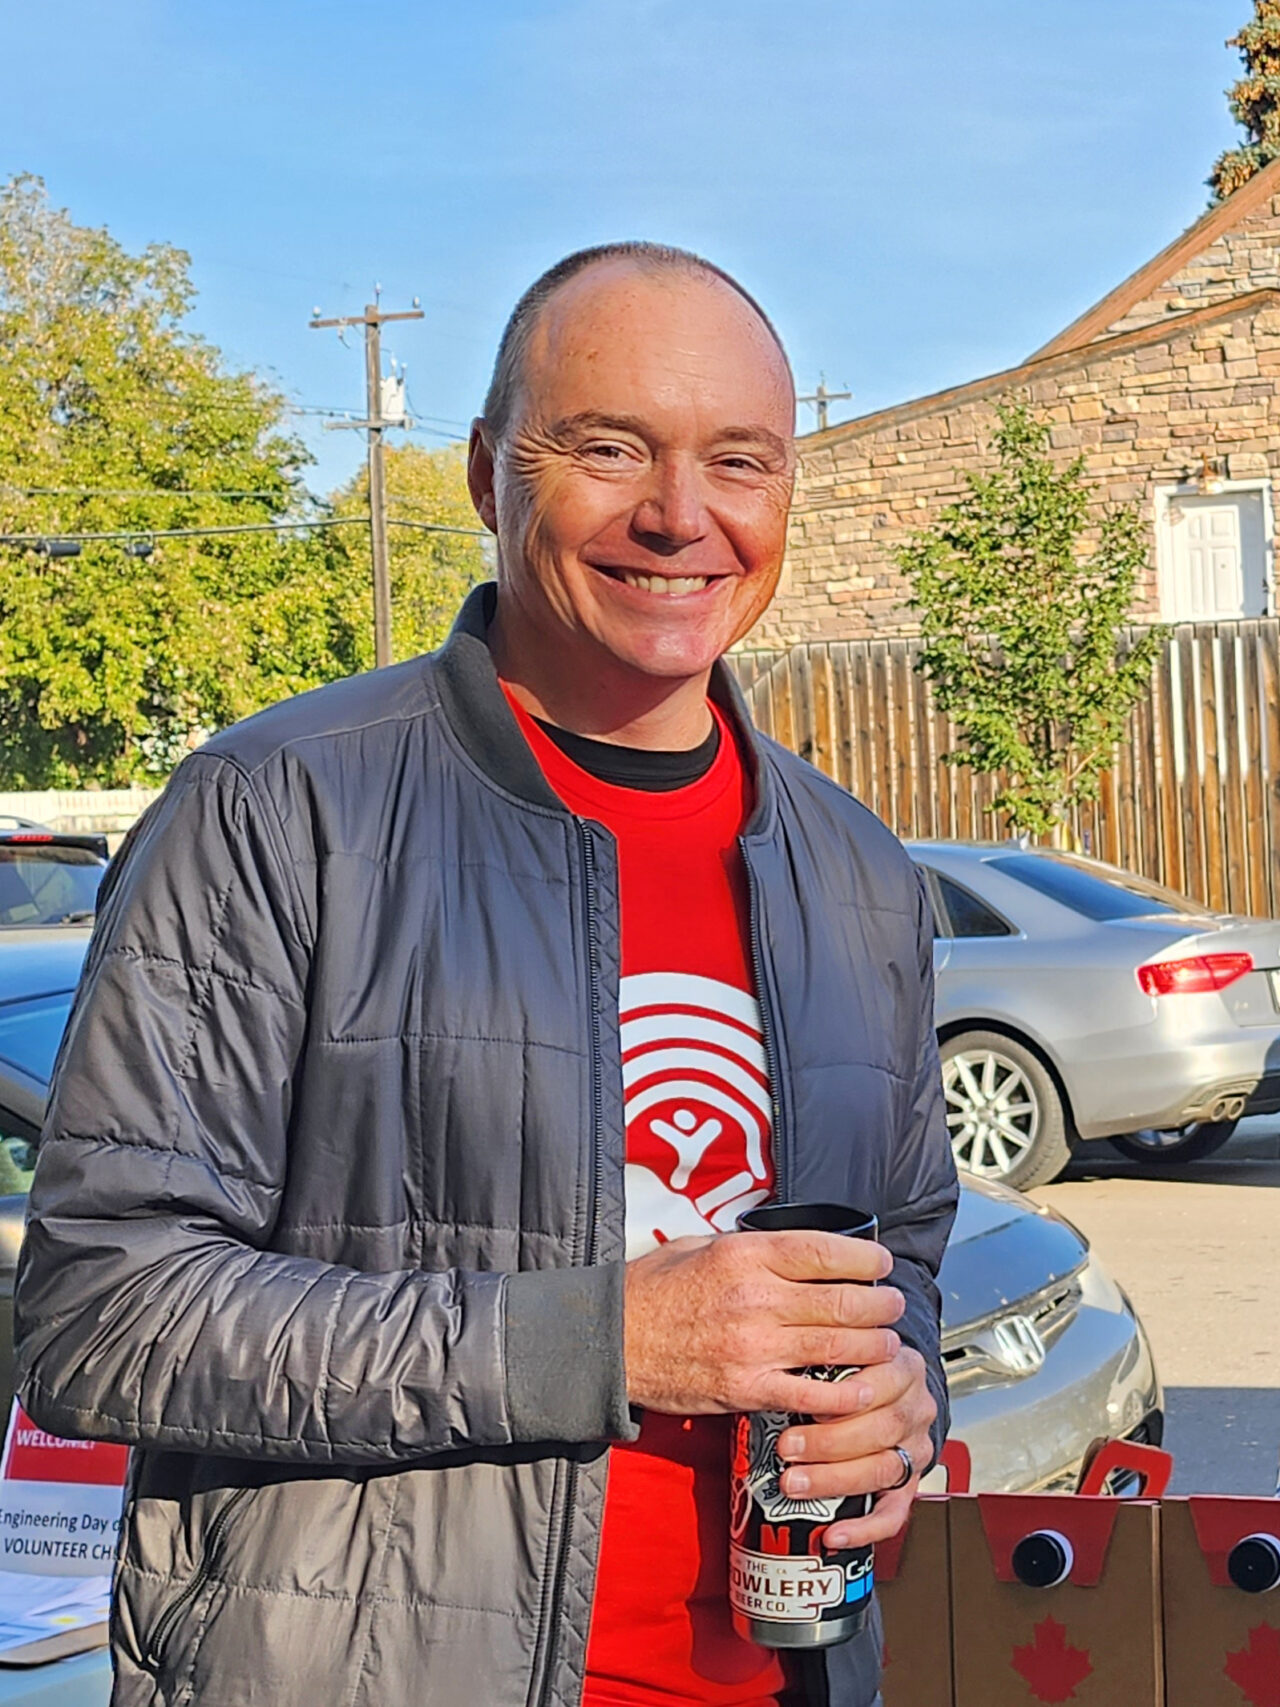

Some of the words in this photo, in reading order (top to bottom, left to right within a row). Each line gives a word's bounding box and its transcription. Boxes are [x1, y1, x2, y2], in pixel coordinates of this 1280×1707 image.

[81, 1513, 108, 1535] Day
[4, 1538, 88, 1559] VOLUNTEER
[747, 1560, 768, 1574] THE
[732, 1568, 832, 1597] OWLERY
[766, 1600, 790, 1613] CO.
